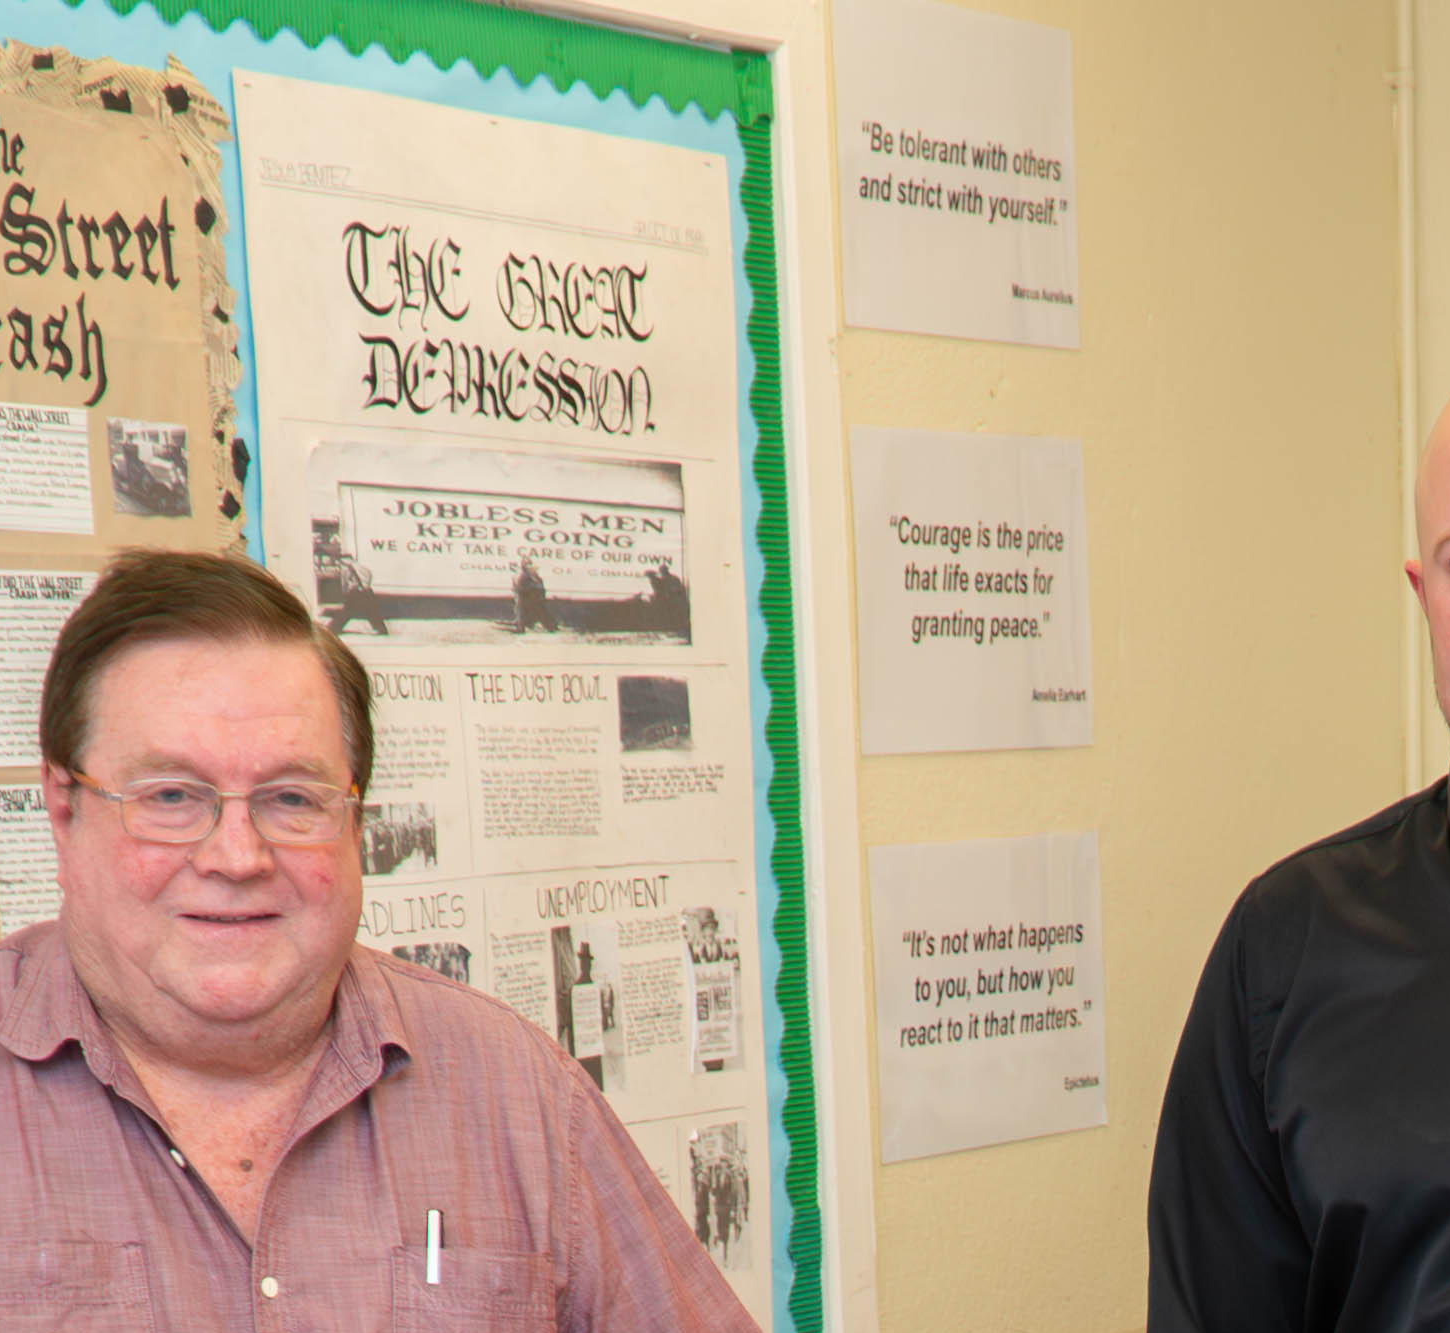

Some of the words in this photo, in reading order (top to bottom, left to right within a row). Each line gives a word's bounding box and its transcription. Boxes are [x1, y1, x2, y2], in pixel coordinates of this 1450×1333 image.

[899, 129, 966, 167] tolerant
[971, 140, 1008, 173] with
[1012, 149, 1062, 182] others
[859, 173, 892, 202] and
[896, 180, 943, 210] strict
[947, 184, 983, 216] with
[0, 183, 181, 291] Street
[383, 500, 559, 526] JOBLESS
[580, 513, 665, 534] MEN
[370, 538, 398, 552] WE
[465, 543, 507, 556] TAKE
[516, 546, 567, 560] CARE
[570, 549, 594, 561] OF
[601, 551, 631, 564] OUR
[637, 554, 674, 566] OWN
[416, 522, 512, 543] KEEP
[523, 529, 635, 549] GOING
[977, 520, 991, 549] is
[997, 521, 1022, 550] the
[1026, 524, 1064, 558] price
[57, 577, 83, 589] STREET
[904, 561, 938, 592] that
[943, 563, 969, 593] life
[974, 568, 1028, 595] exacts
[1033, 566, 1054, 595] for
[911, 609, 985, 645] granting
[465, 673, 506, 704] THE
[512, 674, 554, 702] DUST
[561, 674, 608, 703] BOWL
[536, 875, 670, 920] UNEMPLOYMENT
[940, 928, 968, 955] not
[973, 924, 1013, 951] what
[1018, 921, 1084, 954] happens
[914, 977, 931, 1002] to
[936, 976, 971, 1007] you,
[976, 968, 1004, 996] but
[1008, 965, 1044, 992] how
[1047, 965, 1075, 996] you
[900, 1017, 942, 1048] react
[947, 1018, 963, 1043] to
[968, 1013, 979, 1040] it
[984, 1010, 1015, 1039] that
